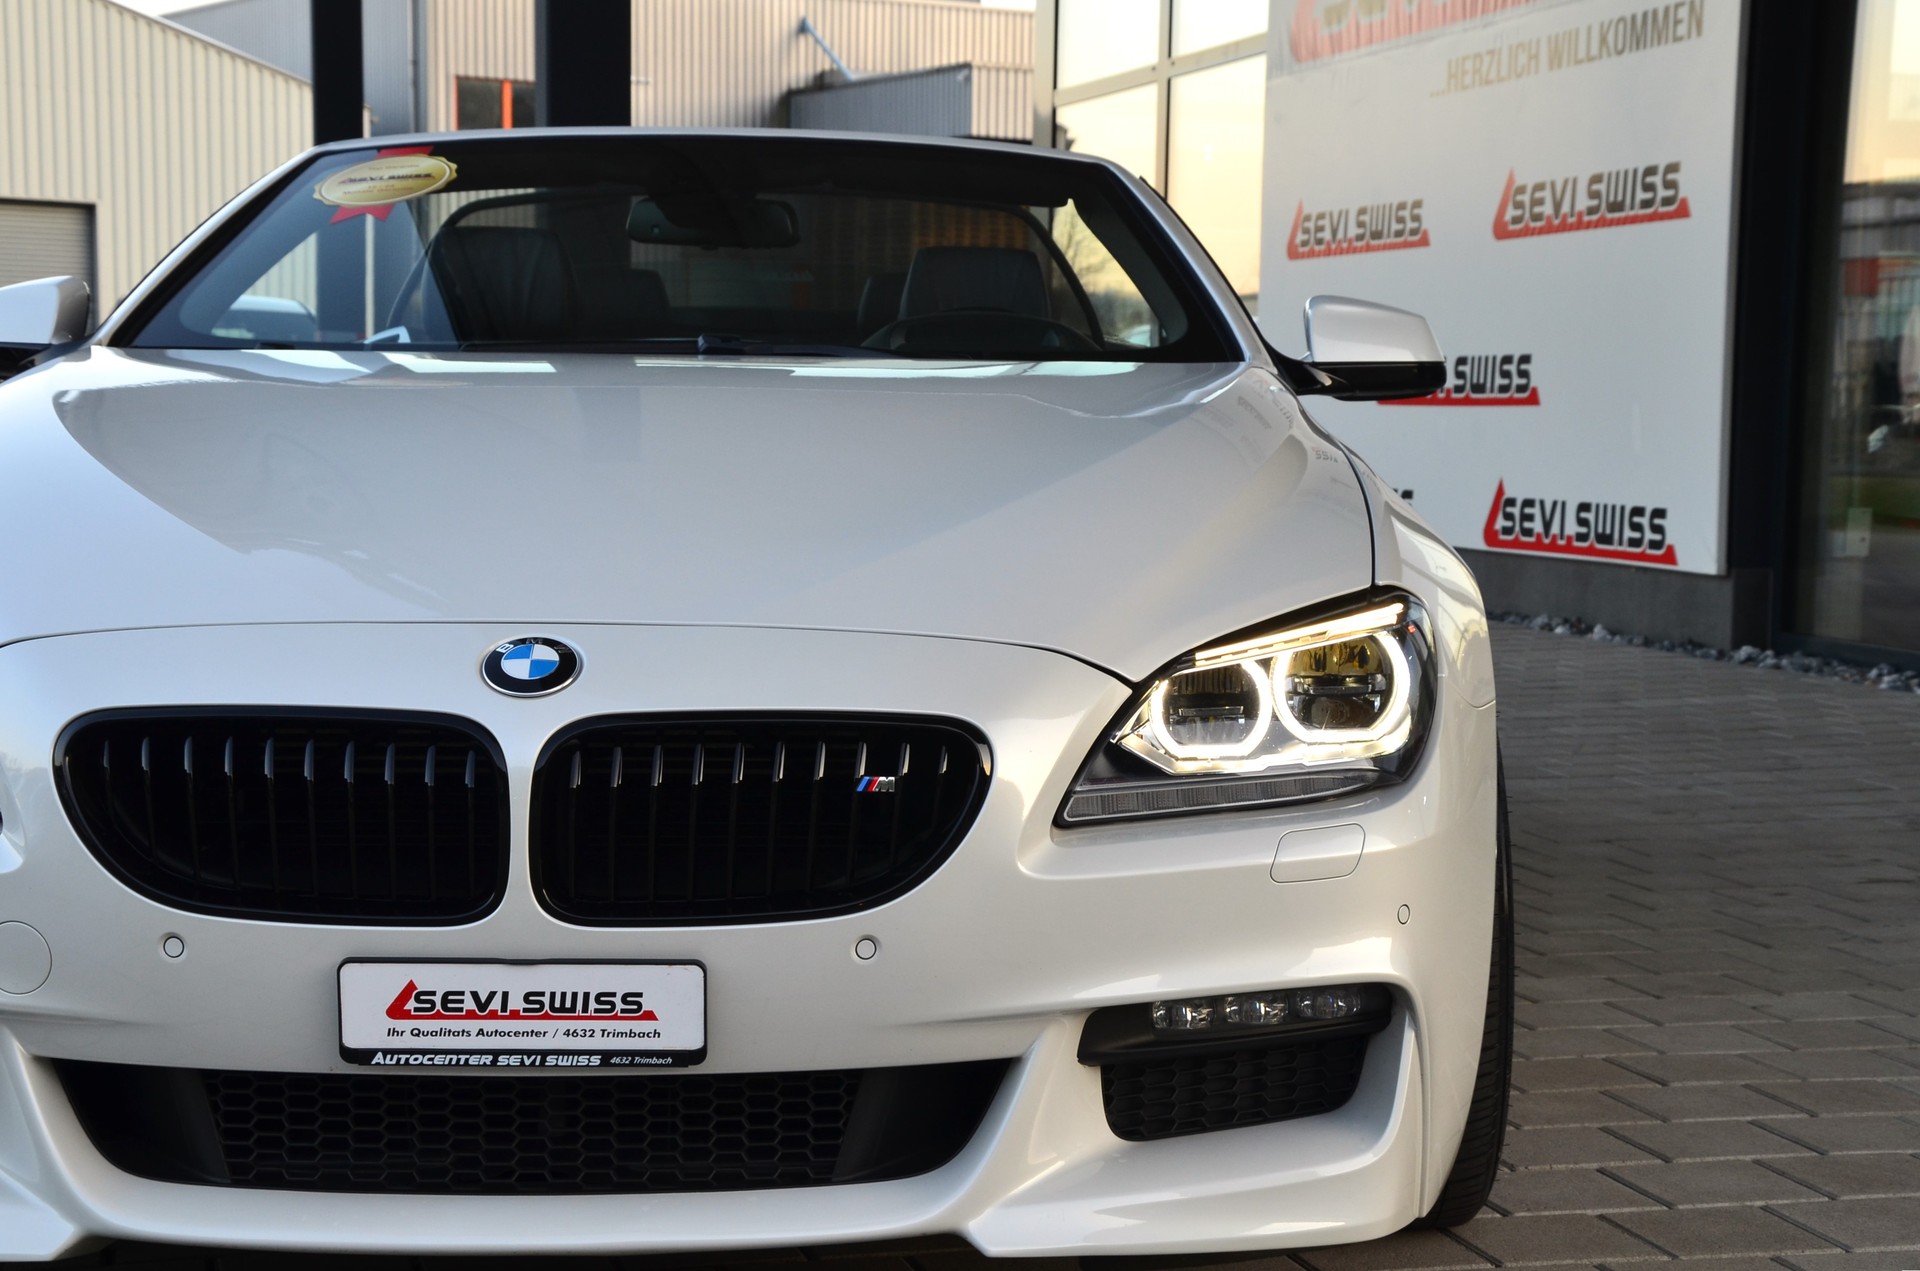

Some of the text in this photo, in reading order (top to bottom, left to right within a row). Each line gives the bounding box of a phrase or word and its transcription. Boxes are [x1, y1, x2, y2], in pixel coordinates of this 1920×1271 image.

[1546, 0, 1705, 71] WILLKOMMEN
[1510, 161, 1682, 226] SEVI SWISS
[1299, 199, 1424, 248] SEVI SWISS
[1452, 353, 1532, 395] SWISS
[1500, 497, 1667, 551] SEVI SWISS
[412, 990, 644, 1015] SEVI SWISS
[386, 1027, 661, 1039] Ihr Qualitats Autocenter / 4632 Trimbach
[496, 1054, 541, 1067] SEVI
[544, 1055, 602, 1067] SWISS
[609, 1056, 632, 1065] 4632
[633, 1056, 673, 1065] Trimbach
